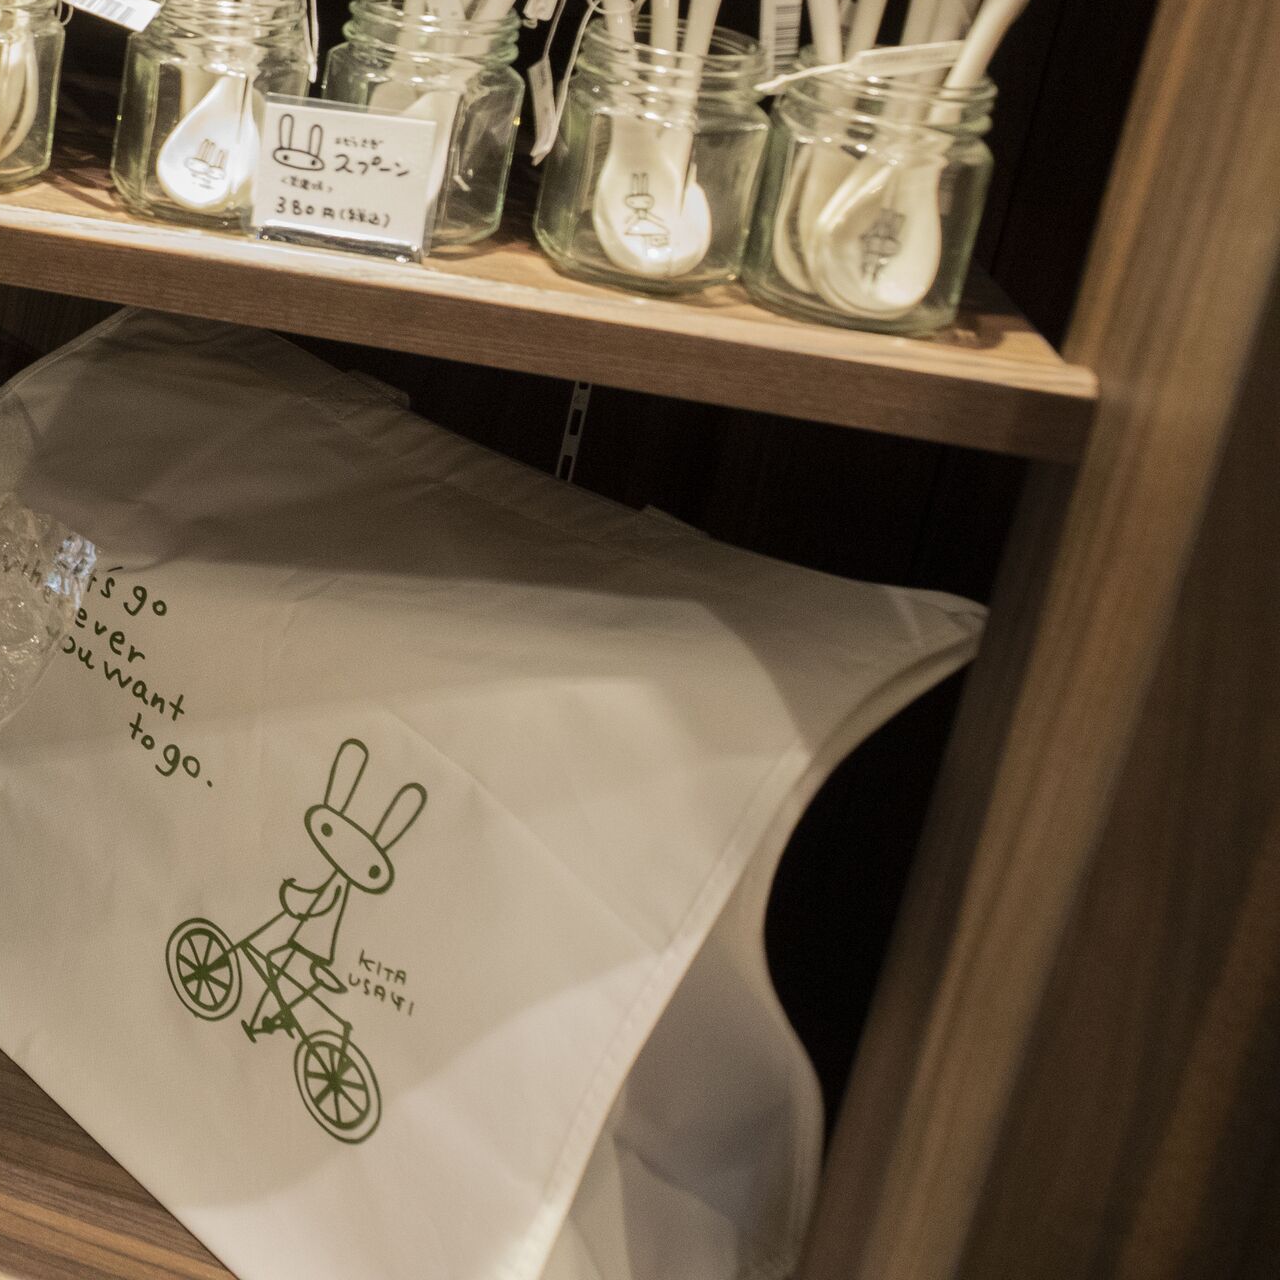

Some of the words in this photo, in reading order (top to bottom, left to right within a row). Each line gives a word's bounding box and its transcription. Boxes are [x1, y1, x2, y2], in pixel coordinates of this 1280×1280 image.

[335, 154, 410, 177] スプーン
[276, 196, 392, 228] 380円(税込)
[123, 585, 167, 616] go
[104, 661, 185, 721] want
[129, 712, 155, 750] to
[155, 744, 213, 788] go.
[359, 949, 406, 986] KITA
[348, 973, 414, 1016] USAGI
